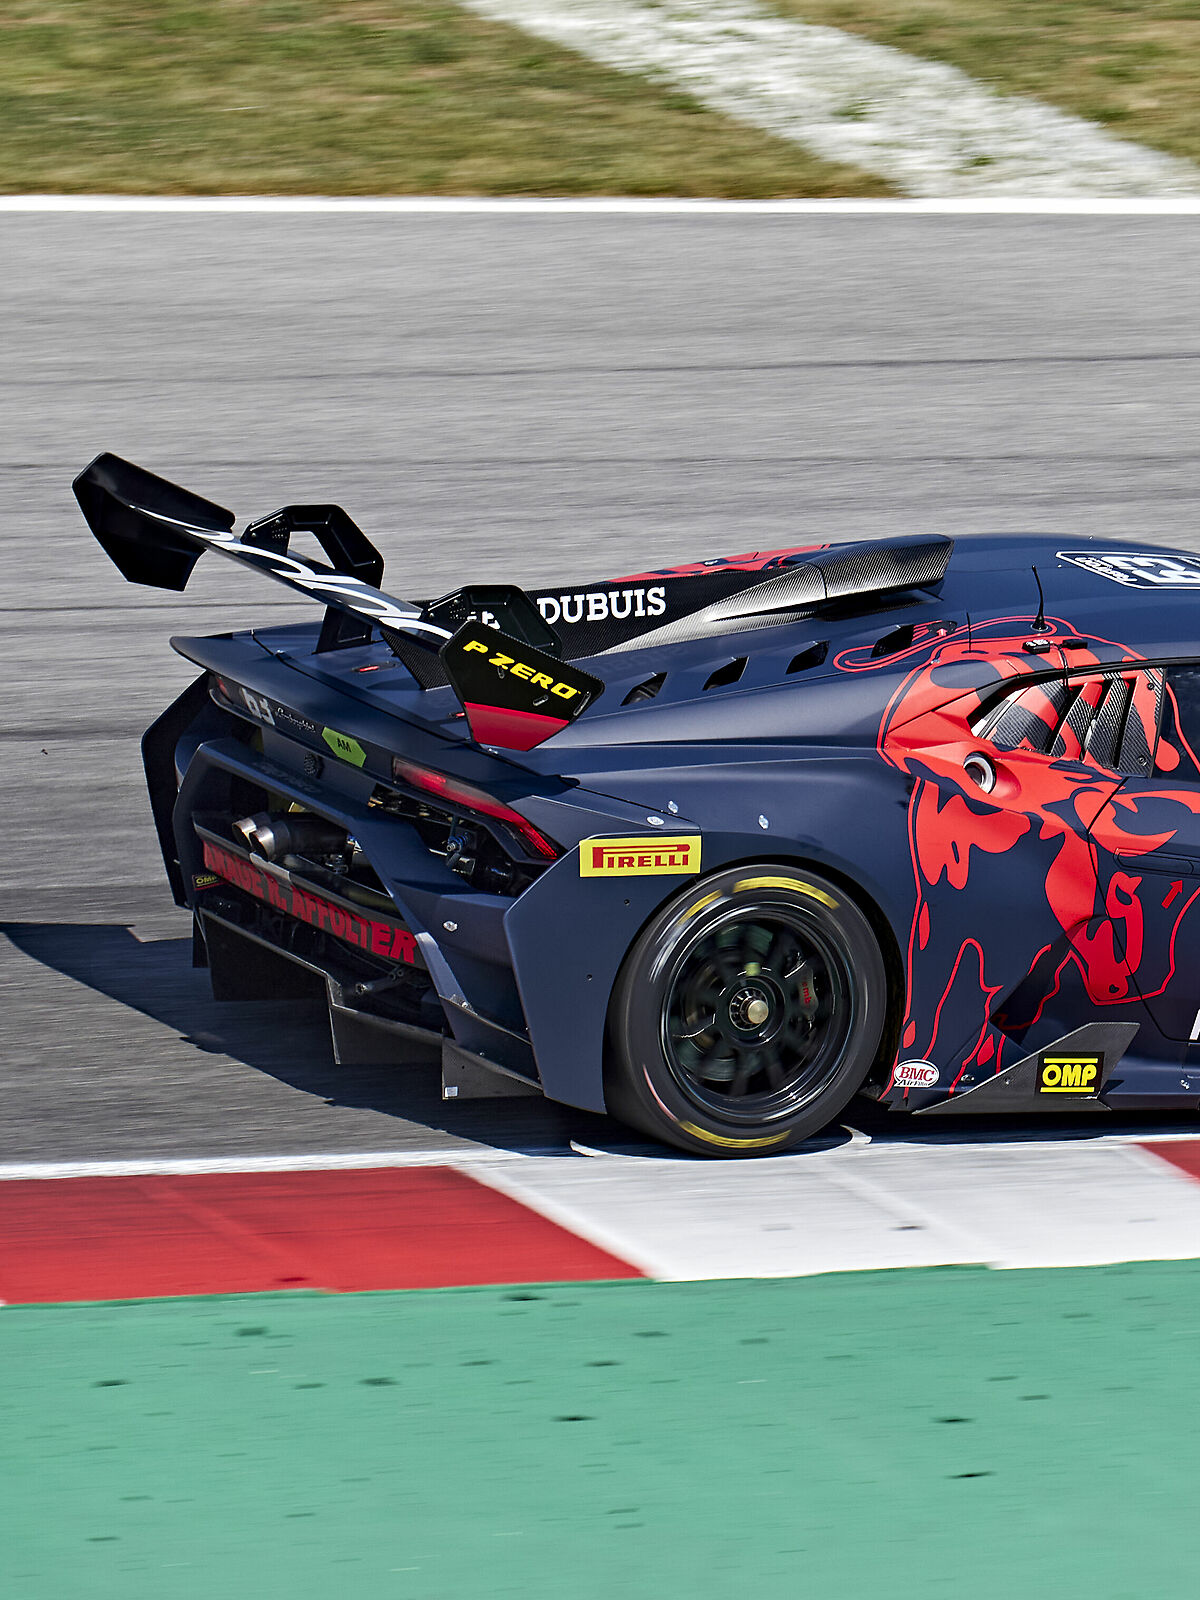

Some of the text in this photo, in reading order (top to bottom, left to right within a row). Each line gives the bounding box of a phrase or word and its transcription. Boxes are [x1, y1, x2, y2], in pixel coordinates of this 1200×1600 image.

[536, 586, 667, 625] DUBUIS
[462, 640, 578, 700] P ZERO
[336, 737, 353, 753] AM
[592, 844, 691, 869] PIRELLI
[290, 884, 418, 965] AFFOLTER
[899, 1066, 935, 1082] BMC
[1042, 1064, 1097, 1087] OMP
